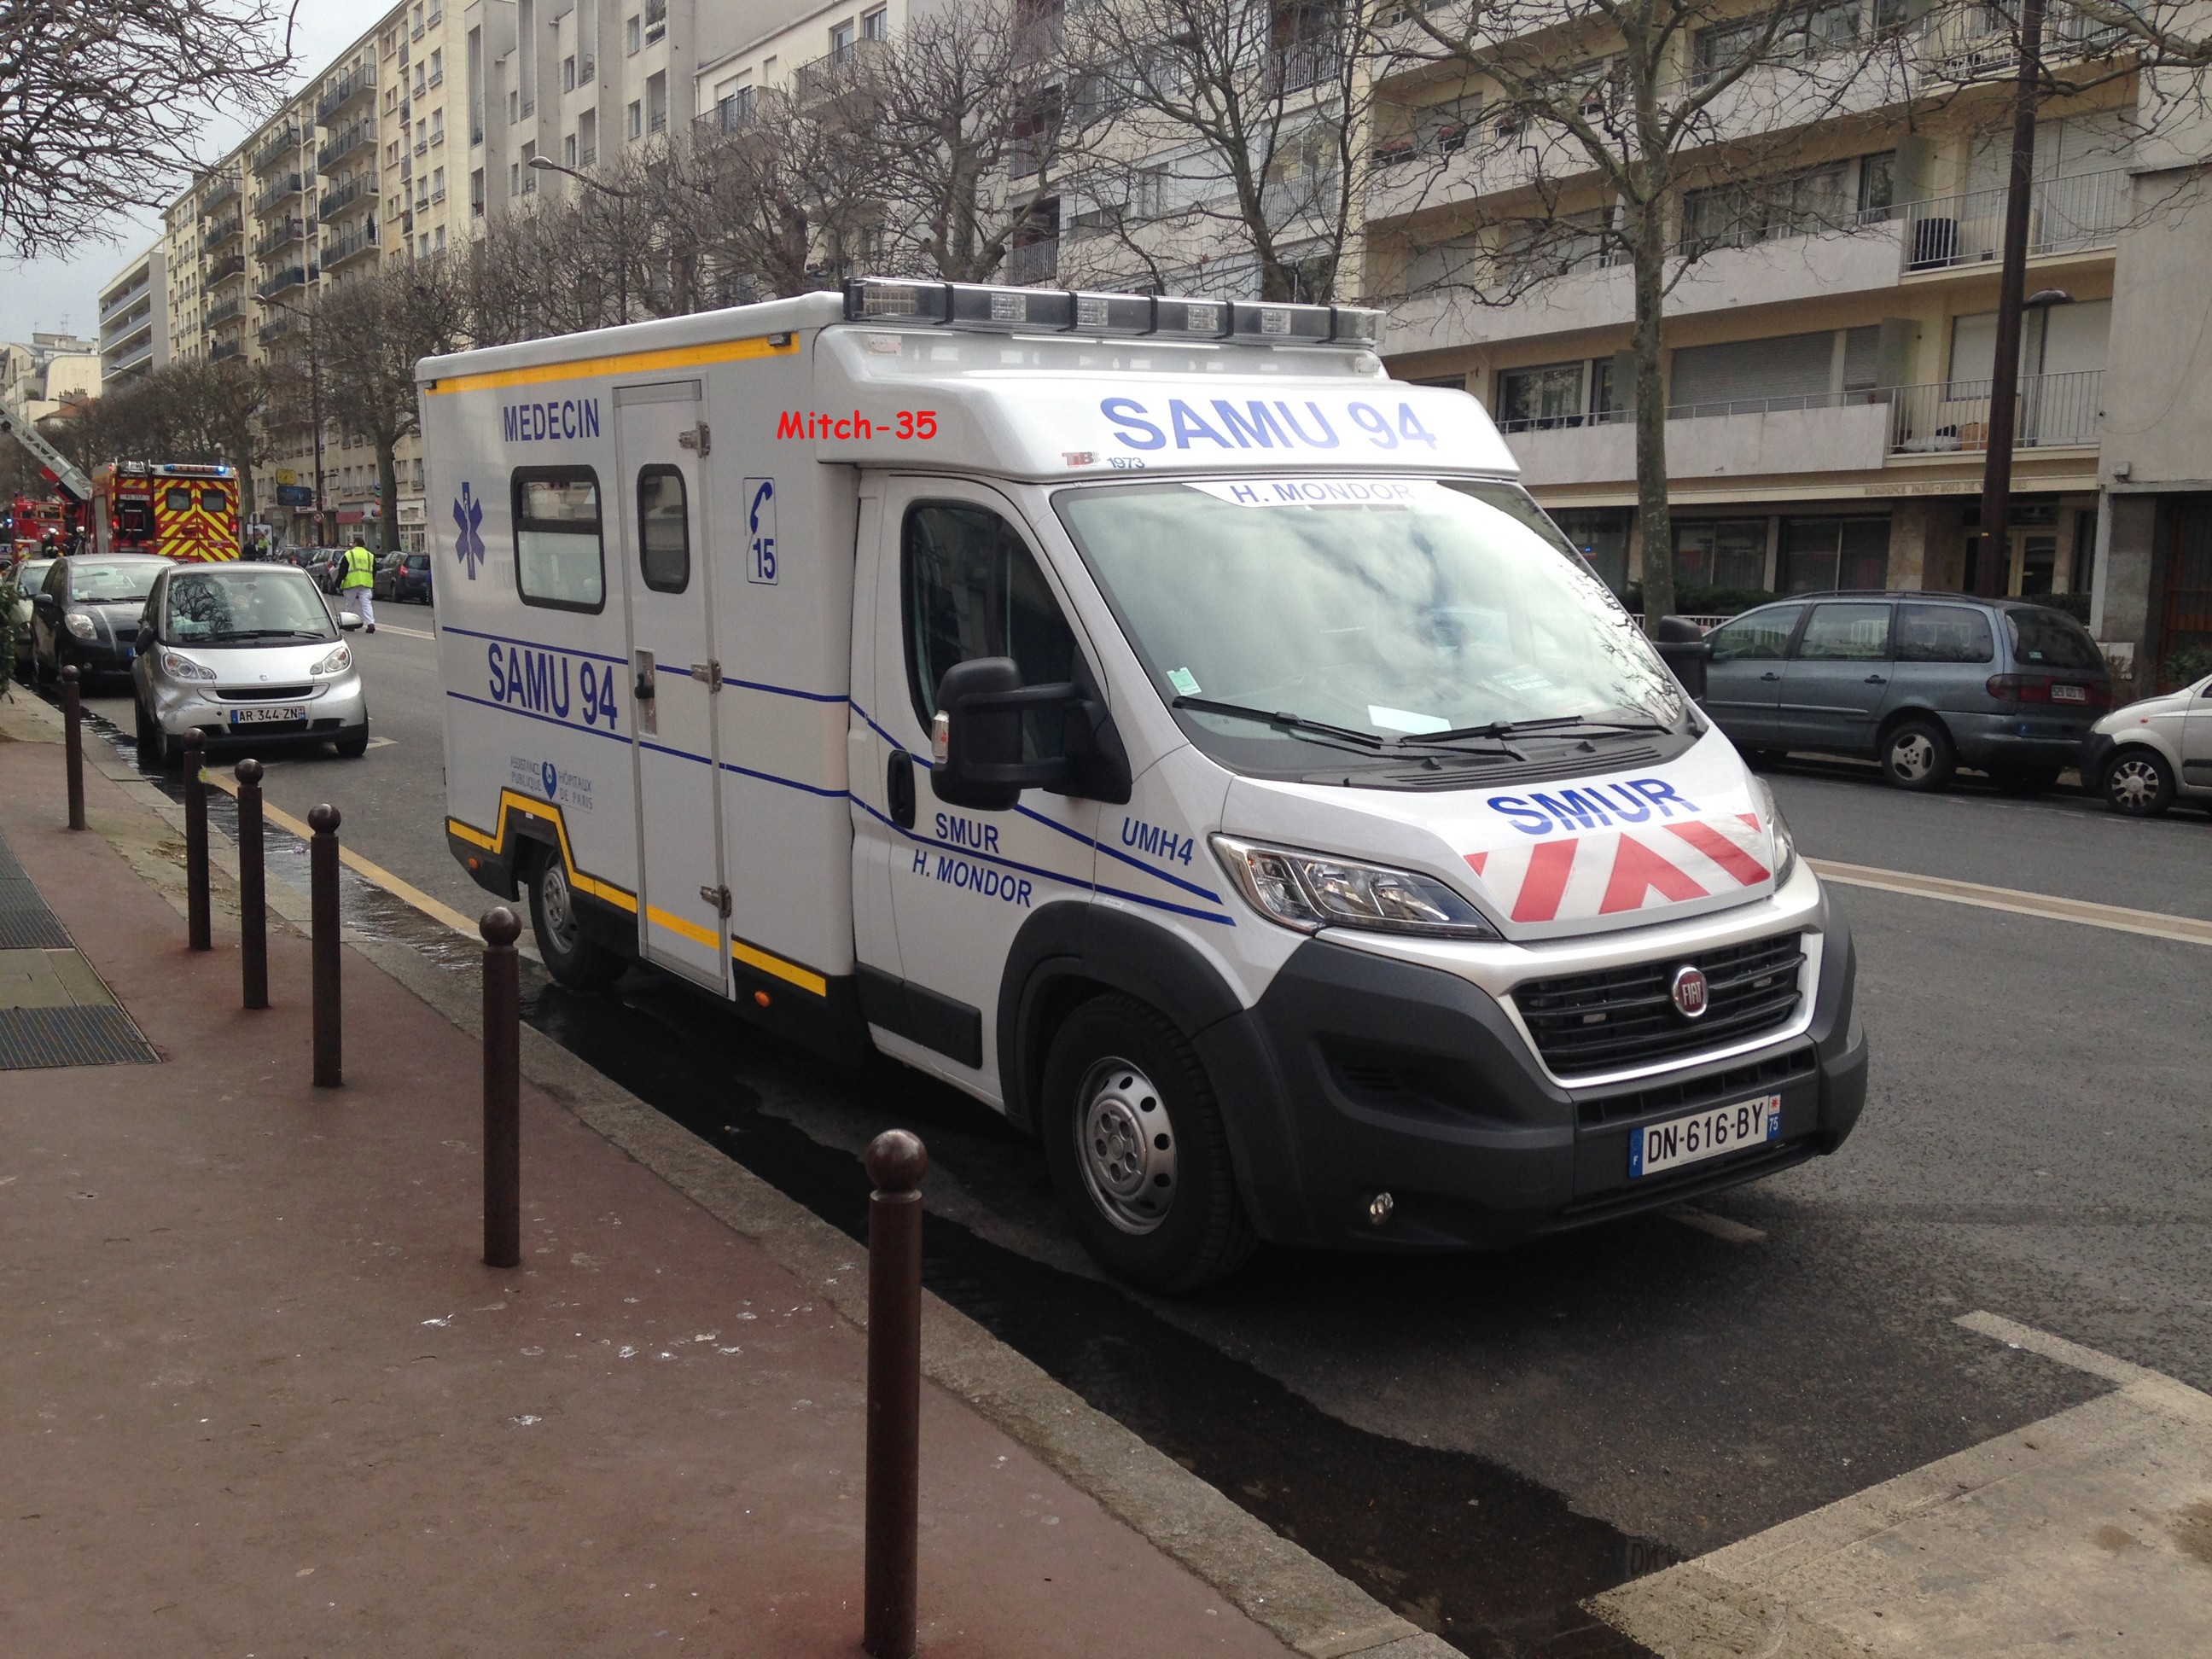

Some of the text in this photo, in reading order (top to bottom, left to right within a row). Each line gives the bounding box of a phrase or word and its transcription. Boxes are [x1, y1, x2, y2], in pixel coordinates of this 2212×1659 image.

[503, 398, 600, 442] MEDECIN
[1100, 397, 1437, 451] SAMU 94
[1106, 457, 1145, 469] 1973
[1230, 482, 1416, 504] H. MONDOR
[753, 538, 776, 579] 15
[488, 643, 618, 731] SAMU 94
[510, 756, 540, 776] ASSISTANCE
[511, 771, 542, 792] PUBLIQUE
[559, 788, 593, 810] DE PARIS
[1487, 777, 1703, 835] SMUR
[935, 812, 1000, 854] SMUR
[1121, 817, 1195, 866] UMH4
[912, 849, 1033, 908] H. MONDOR
[1682, 981, 1701, 1006] FIAT
[1647, 1102, 1764, 1164] DN-616-BY
[1768, 1116, 1778, 1132] 75
[1633, 1155, 1639, 1166] F
